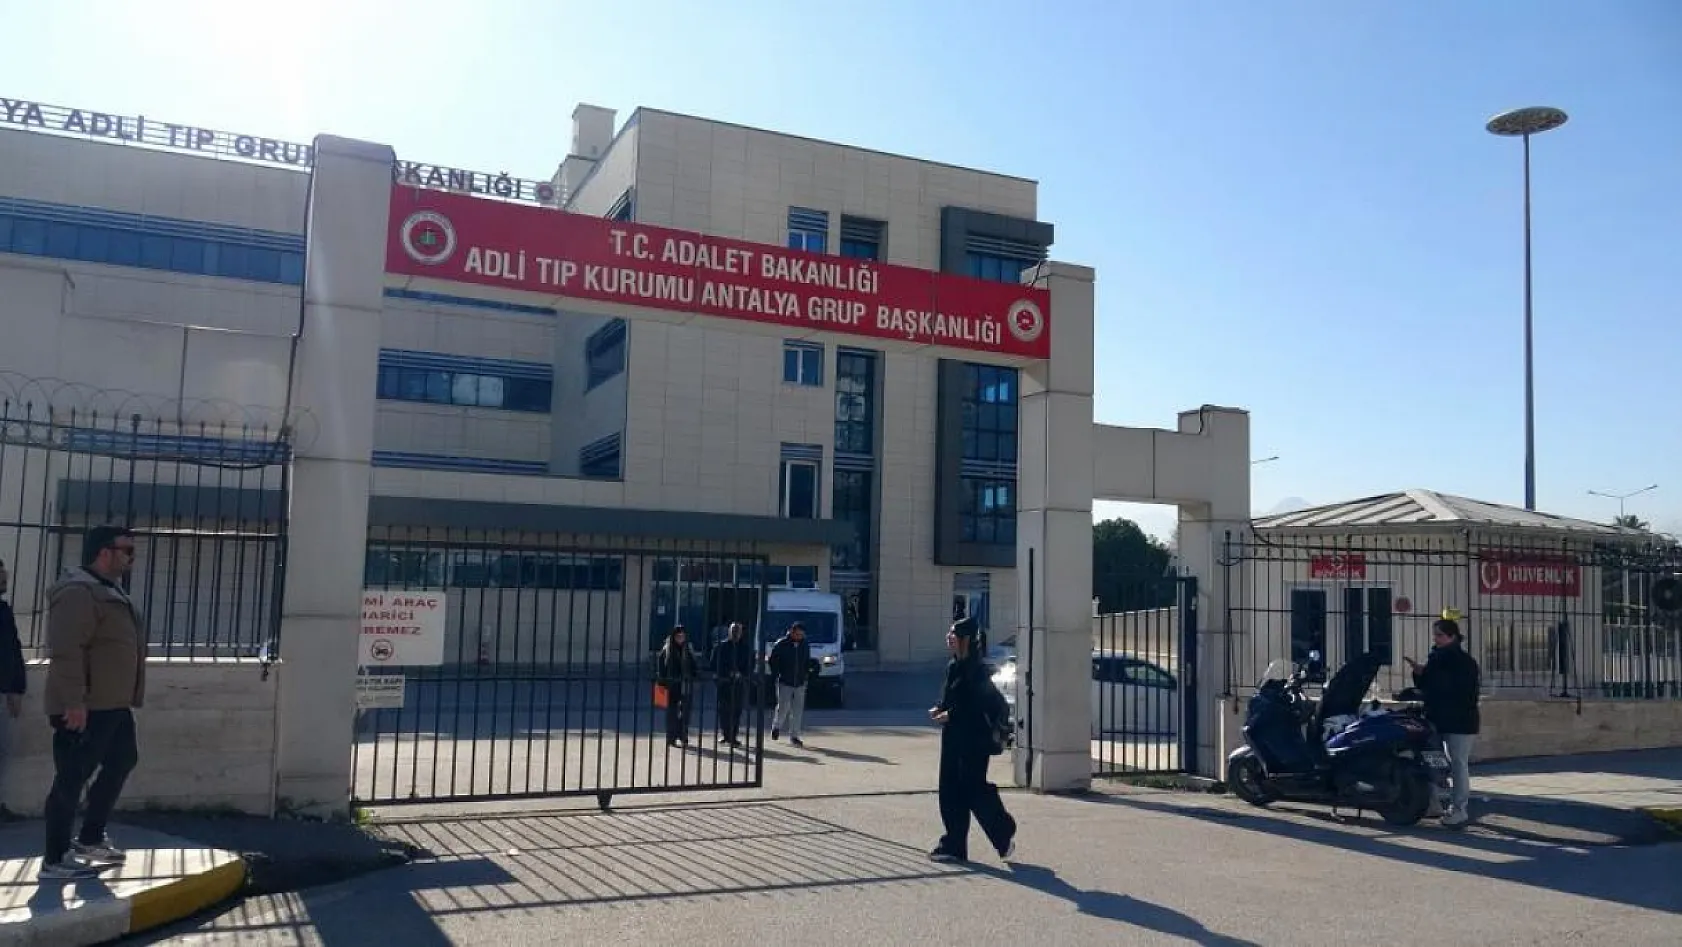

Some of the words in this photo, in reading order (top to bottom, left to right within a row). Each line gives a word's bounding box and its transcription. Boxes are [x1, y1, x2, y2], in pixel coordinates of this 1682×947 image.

[64, 108, 145, 142] ADLİ
[164, 122, 214, 150] TIP
[611, 228, 655, 261] T.C.
[662, 238, 754, 276] ADALET
[761, 253, 878, 294] BAKANLIĞI
[464, 246, 526, 281] ADLİ
[536, 257, 577, 287] TIP
[584, 264, 694, 303] KURUMU
[701, 281, 800, 318] ANTALYA
[808, 296, 866, 325] GRUP
[876, 304, 1001, 344] BAŞKANLIĞI
[391, 597, 438, 610] ARAÇ
